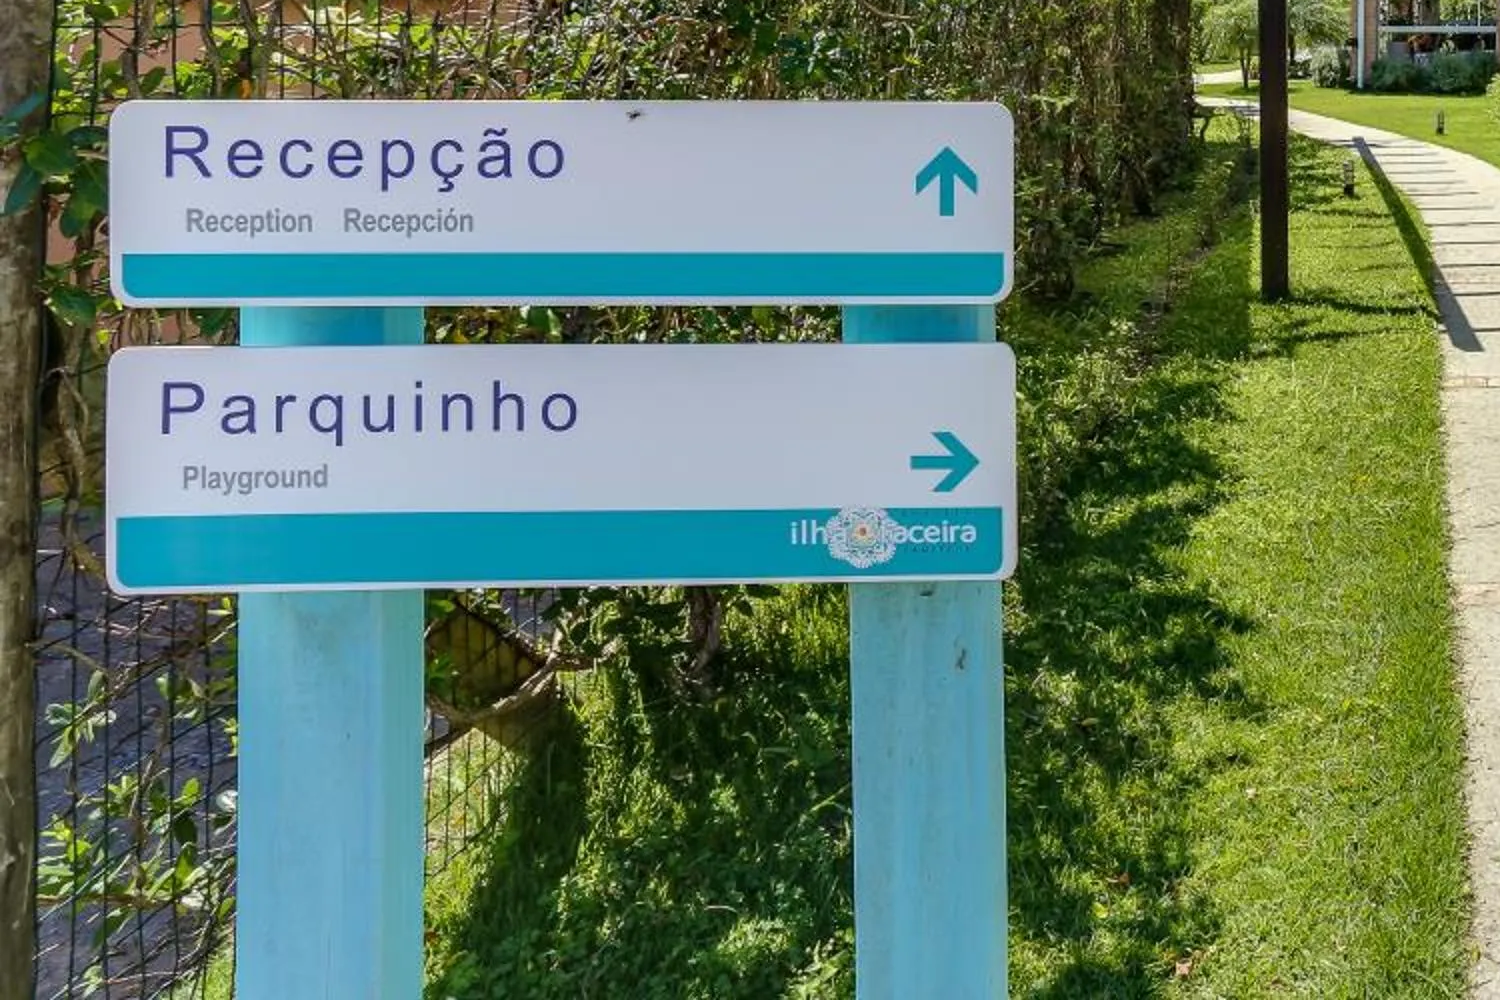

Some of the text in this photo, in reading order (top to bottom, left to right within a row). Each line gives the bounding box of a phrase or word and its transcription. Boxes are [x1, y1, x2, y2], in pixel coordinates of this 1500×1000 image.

[165, 125, 566, 193] Recepção
[186, 207, 474, 239] Reception Recepción
[161, 379, 579, 447] Parquinho
[182, 462, 329, 496] Playground
